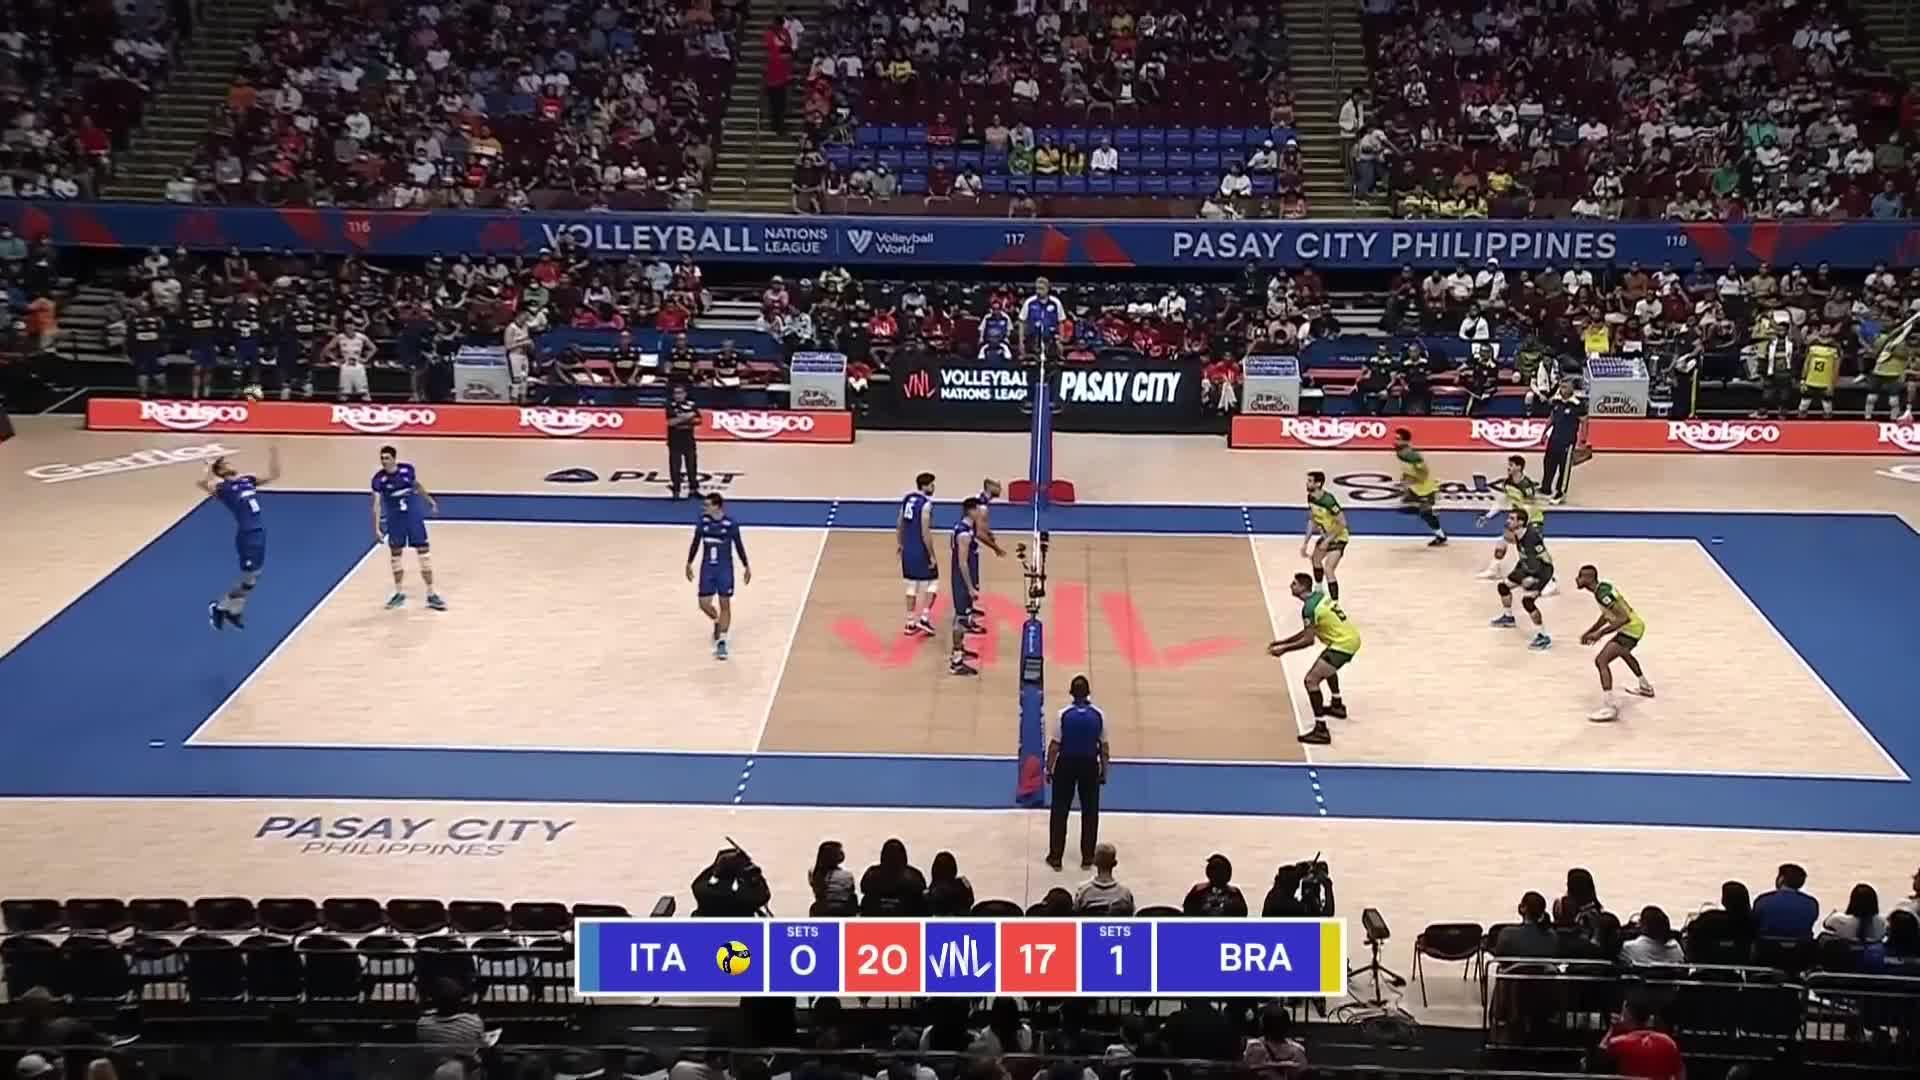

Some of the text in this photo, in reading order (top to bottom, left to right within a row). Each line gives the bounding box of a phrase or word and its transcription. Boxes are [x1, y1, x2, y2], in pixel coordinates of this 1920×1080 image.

[347, 222, 370, 233] 116
[541, 223, 759, 253] VOLLEYBALL
[764, 228, 828, 240] NATIONS
[876, 232, 934, 246] Volleyball
[1004, 233, 1025, 246] 117
[764, 242, 821, 254] LEAGUE
[876, 244, 916, 255] World
[1172, 232, 1617, 258] PASAY CITY PHILIPPINES
[941, 387, 992, 399] NATIONS
[1059, 372, 1181, 402] PASAY CITY
[139, 401, 249, 430] Rebisco
[331, 404, 437, 433] Rebisco
[519, 408, 624, 437] Rebisco
[711, 411, 815, 439] Rebisco
[1280, 417, 1387, 447] Rebisco
[1667, 421, 1780, 451] Rebisco
[255, 816, 575, 841] PASAY CITY
[301, 842, 506, 856] PHILIPPINES
